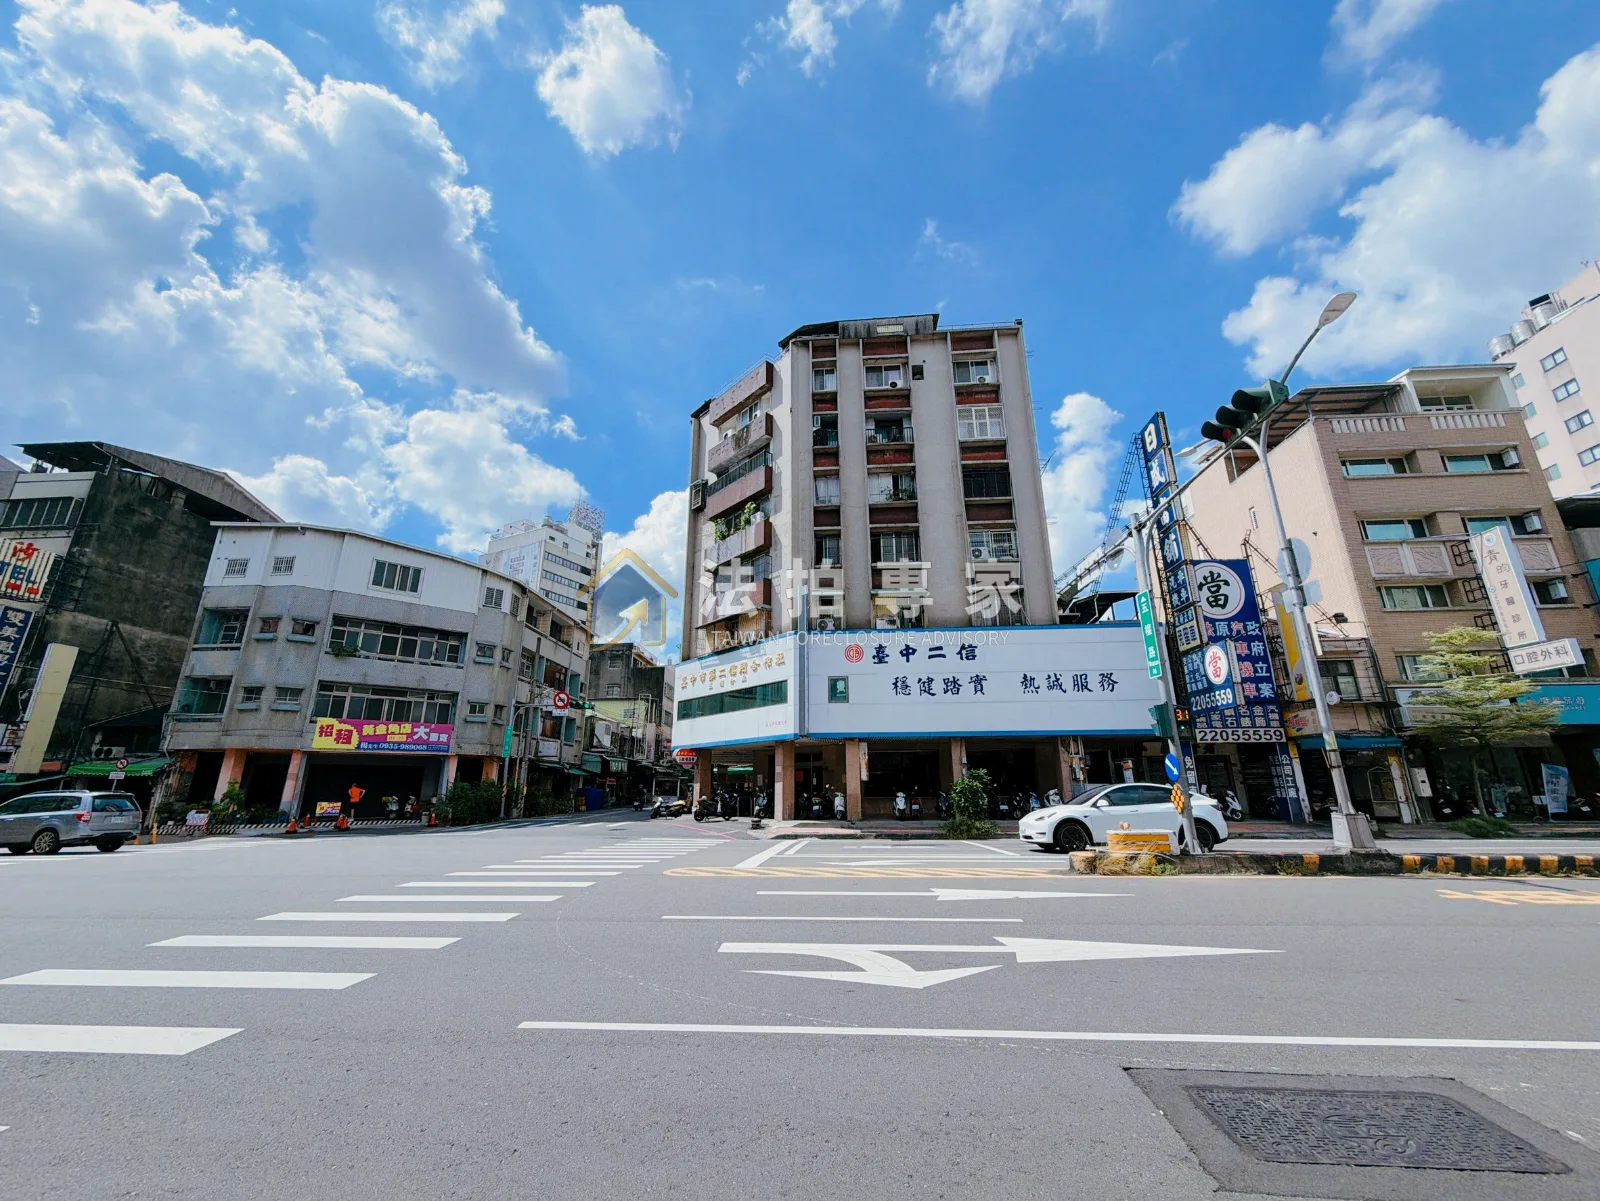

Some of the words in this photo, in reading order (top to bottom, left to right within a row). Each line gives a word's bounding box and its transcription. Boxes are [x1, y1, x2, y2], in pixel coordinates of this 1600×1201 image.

[1197, 571, 1230, 609] 當
[872, 644, 978, 664] 臺中二信
[1208, 651, 1221, 679] 當
[1230, 621, 1258, 698] 汽車機車
[1246, 621, 1275, 698] 政府立案
[1514, 645, 1568, 665] 口腔外科
[892, 674, 988, 697] 穩健踏實
[1020, 672, 1119, 695] 熱誠服務
[1191, 688, 1233, 711] 22055559
[1176, 709, 1189, 720] 31
[1252, 705, 1266, 727] 金飾
[318, 724, 353, 744] 招租
[362, 723, 412, 735] 黃金角店
[1198, 730, 1283, 741] 22055559
[1281, 755, 1298, 797] 公司工廠
